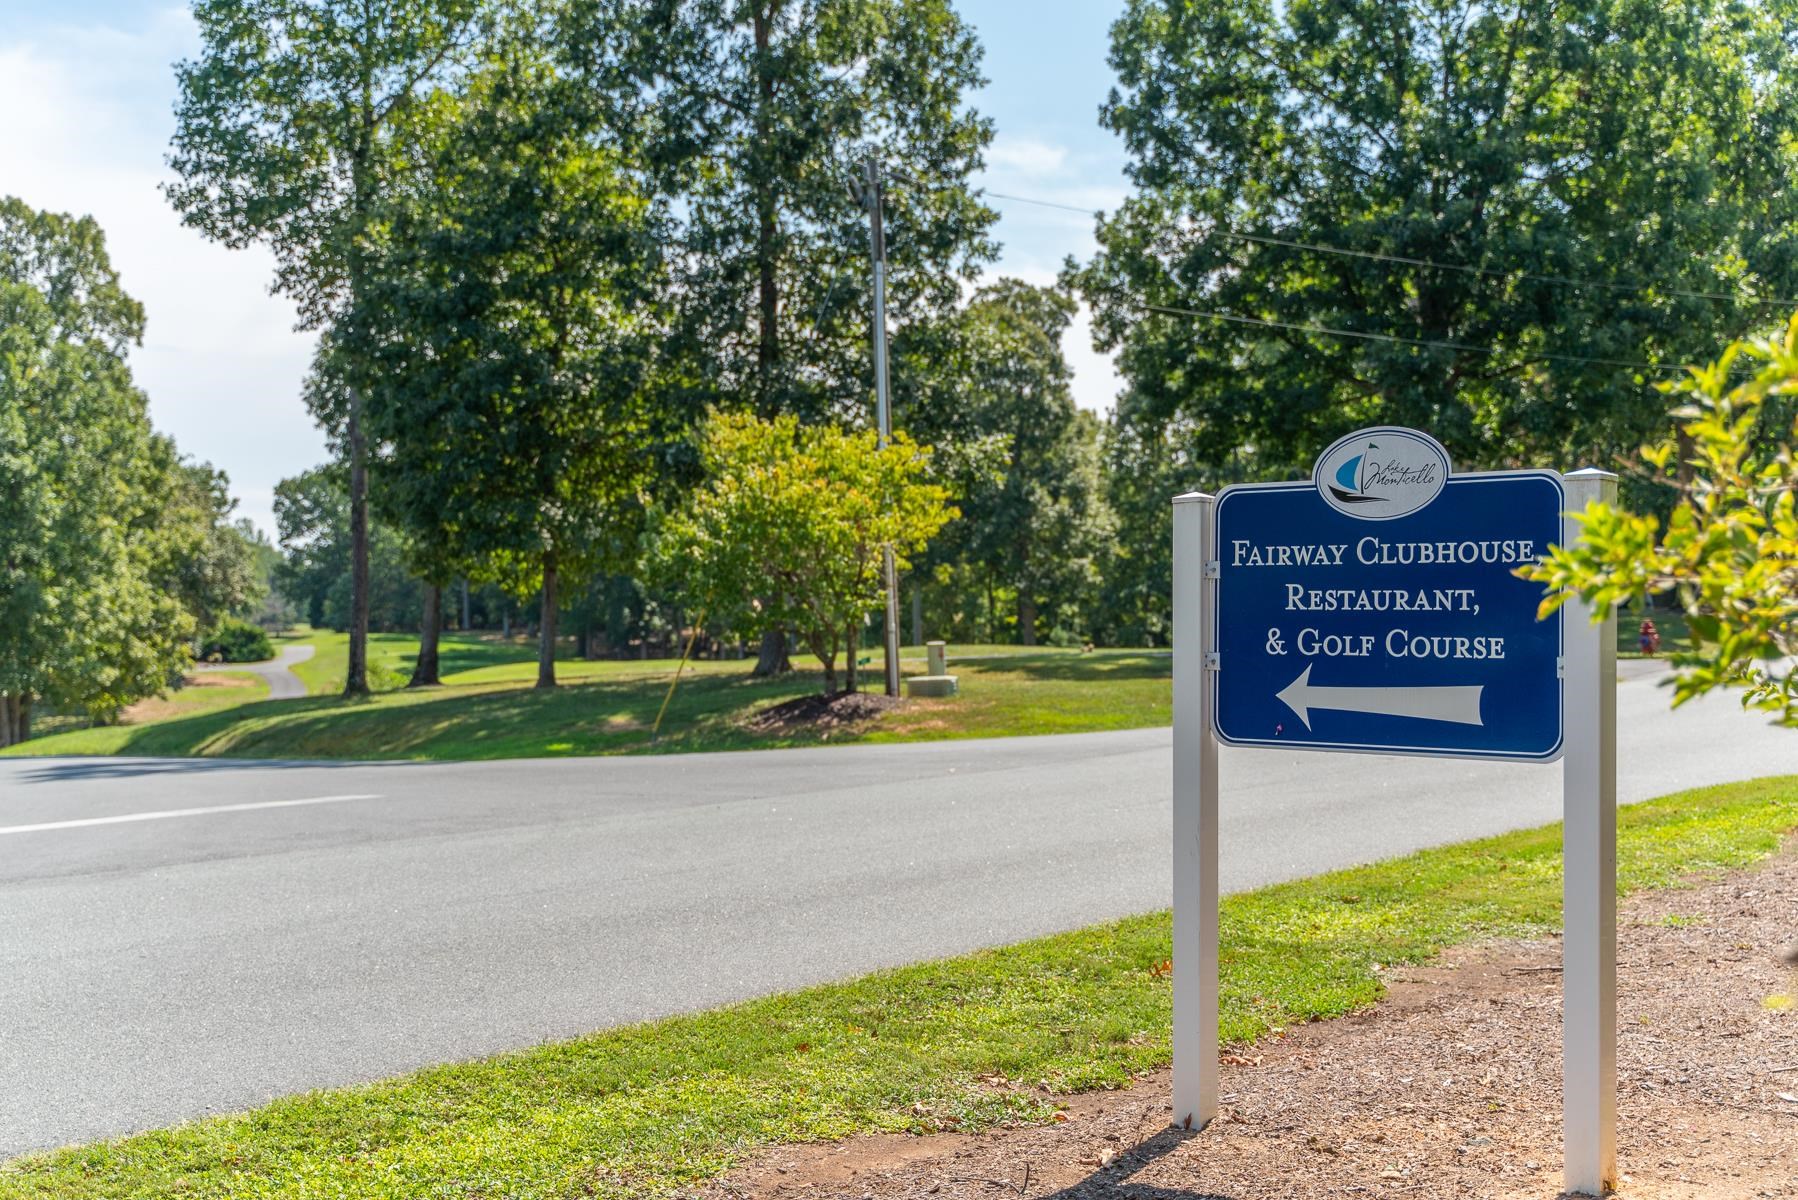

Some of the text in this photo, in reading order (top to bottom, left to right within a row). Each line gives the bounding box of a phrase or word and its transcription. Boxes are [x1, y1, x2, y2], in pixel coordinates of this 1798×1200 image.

[1364, 462, 1436, 490] Monticello
[1232, 540, 1348, 566] FAIRWAY
[1285, 583, 1480, 616] RESTAURANT,
[1265, 628, 1505, 659] & GOLF COURSE
